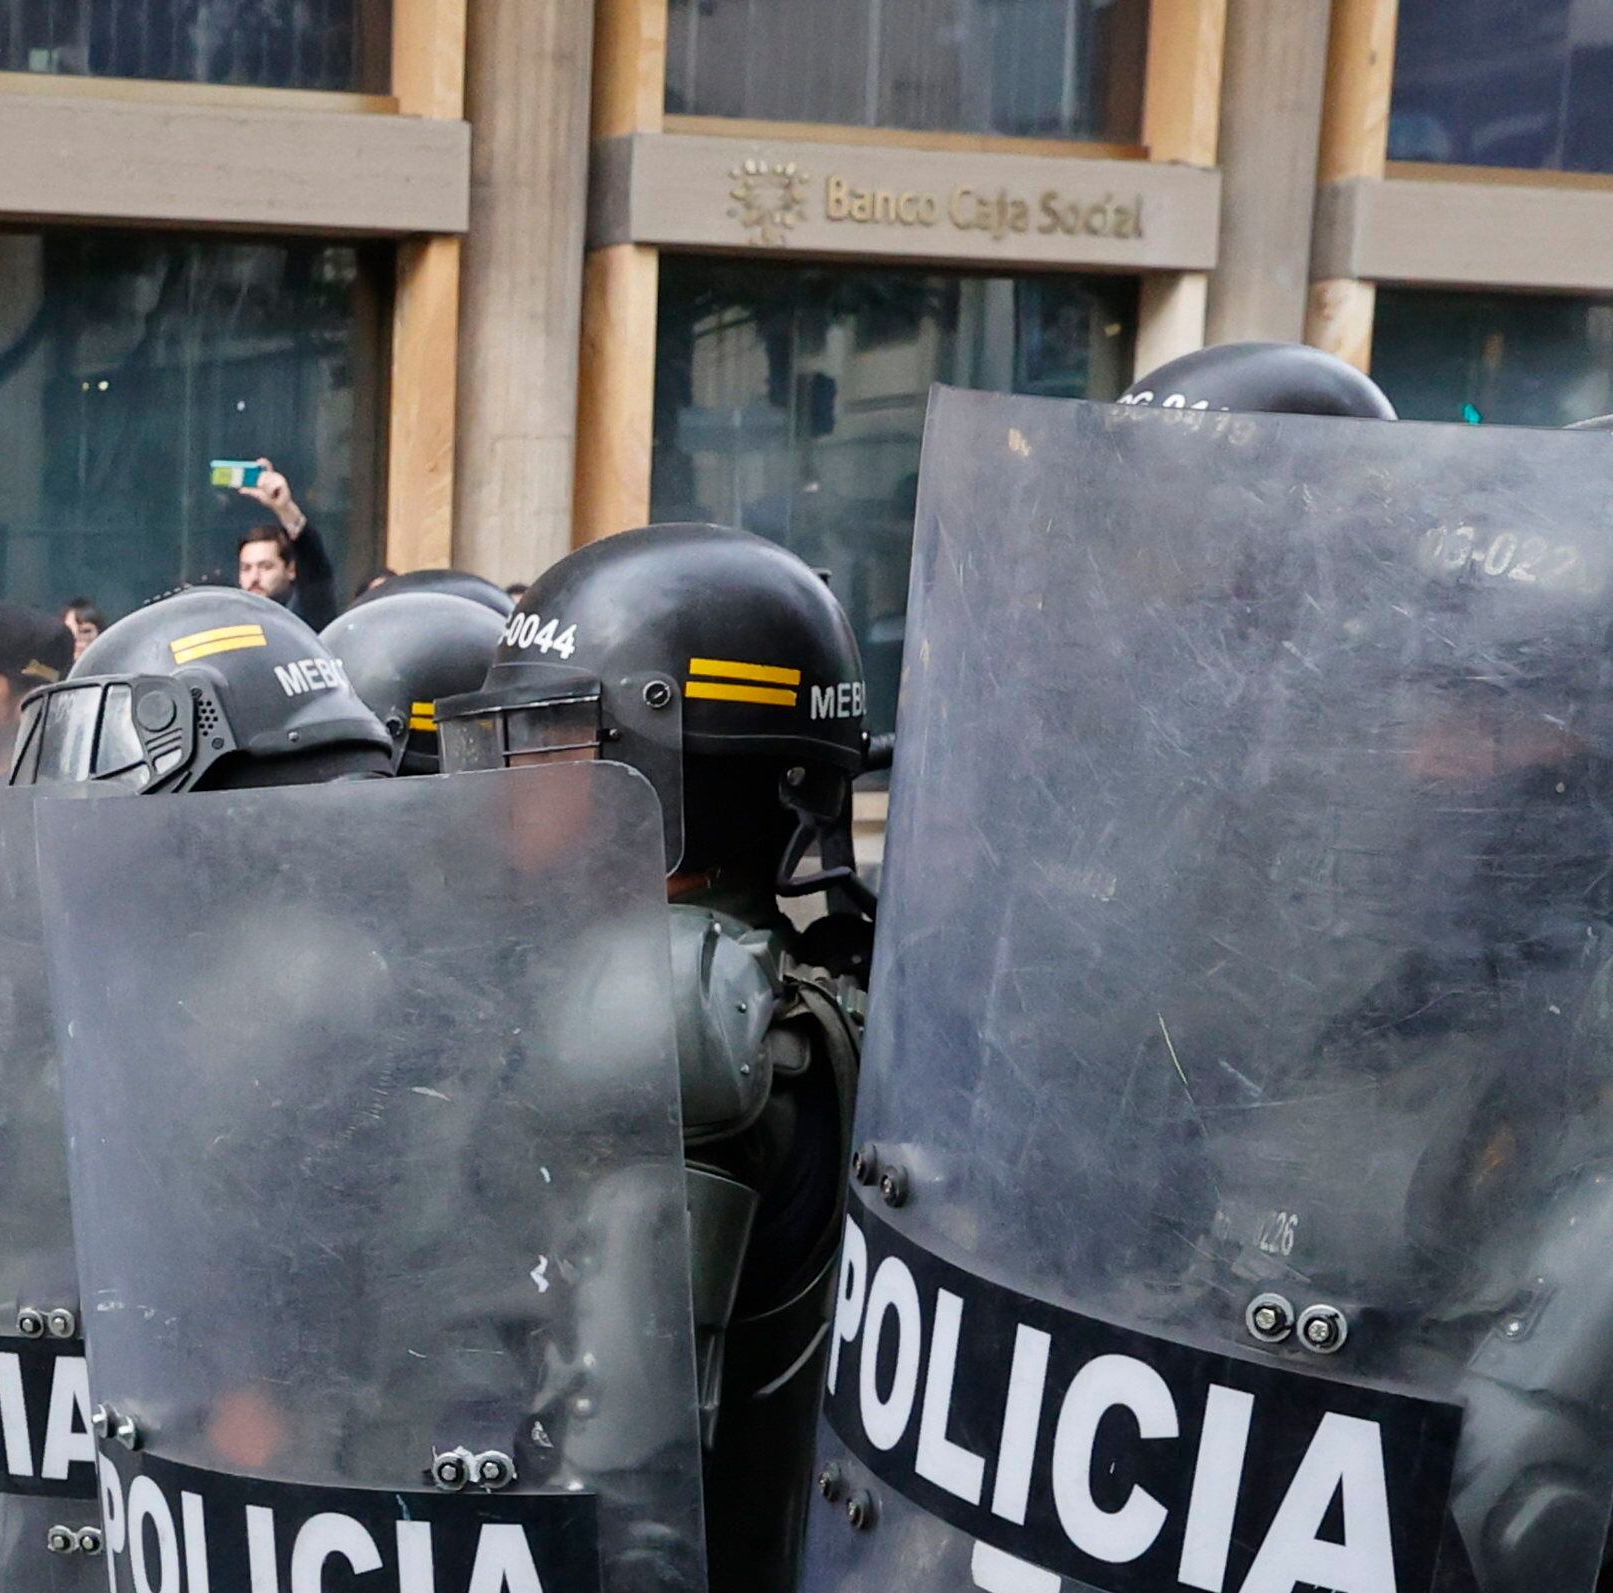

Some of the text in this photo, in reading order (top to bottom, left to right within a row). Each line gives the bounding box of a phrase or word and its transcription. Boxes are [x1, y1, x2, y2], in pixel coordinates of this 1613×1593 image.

[825, 174, 1144, 241] Banco Caja Social
